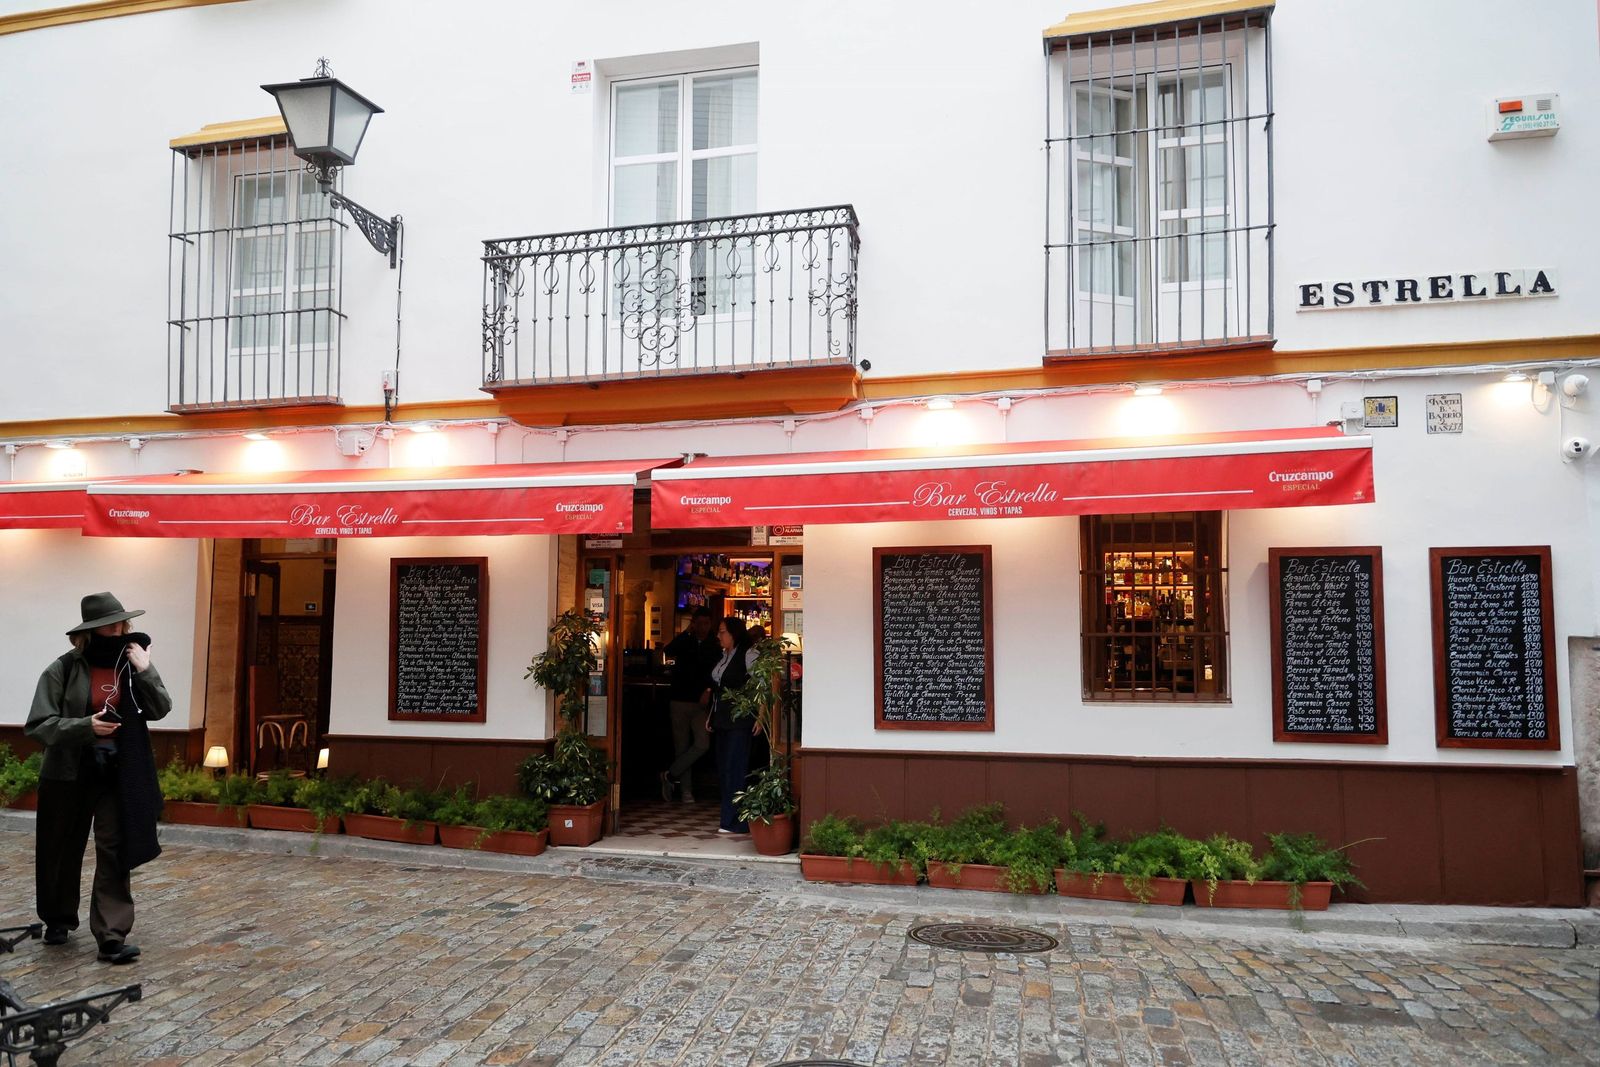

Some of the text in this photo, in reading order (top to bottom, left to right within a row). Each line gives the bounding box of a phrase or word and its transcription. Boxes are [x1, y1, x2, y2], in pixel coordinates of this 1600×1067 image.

[1299, 270, 1555, 307] ESTRELLA
[1268, 470, 1334, 482] Cruzcampo
[912, 480, 1058, 507] Bar Estrella
[556, 502, 604, 512] Cruzcampo
[680, 496, 731, 505] Cruzcampo
[109, 508, 150, 518] Cruzcampo
[290, 504, 399, 526] Bar Estrella
[948, 508, 979, 517] CERVEZAS,
[980, 507, 997, 515] VINOS
[1004, 506, 1022, 514] TAPAS
[918, 554, 966, 568] Estrella
[1285, 559, 1360, 573] Bar Estrella
[1447, 559, 1526, 574] Bar Estrella
[1328, 656, 1350, 665] Cerdo
